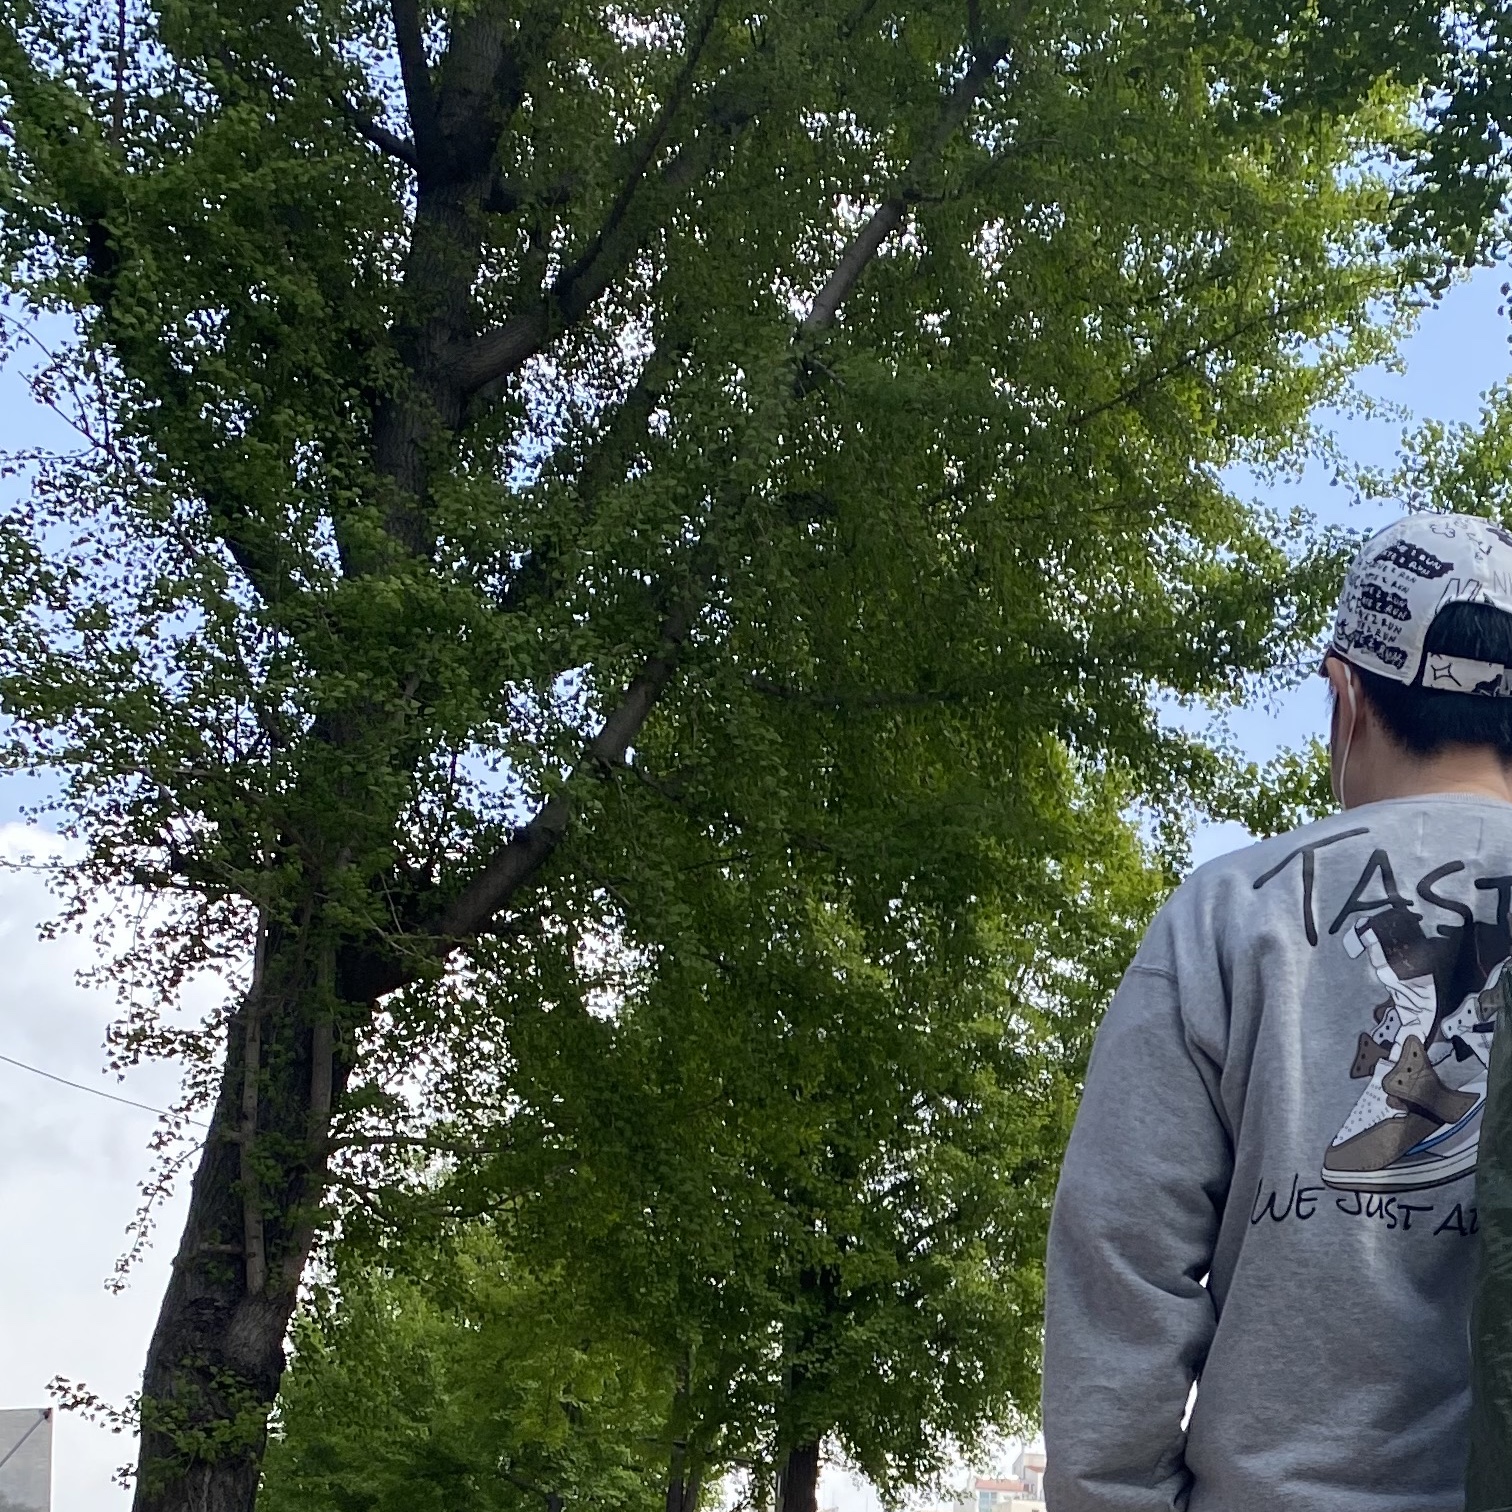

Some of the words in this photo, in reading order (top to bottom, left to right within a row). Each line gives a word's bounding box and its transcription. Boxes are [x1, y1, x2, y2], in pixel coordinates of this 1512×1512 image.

[1382, 618, 1403, 635] RUN
[1251, 1174, 1325, 1225] WE
[1335, 1191, 1434, 1231] JUST
